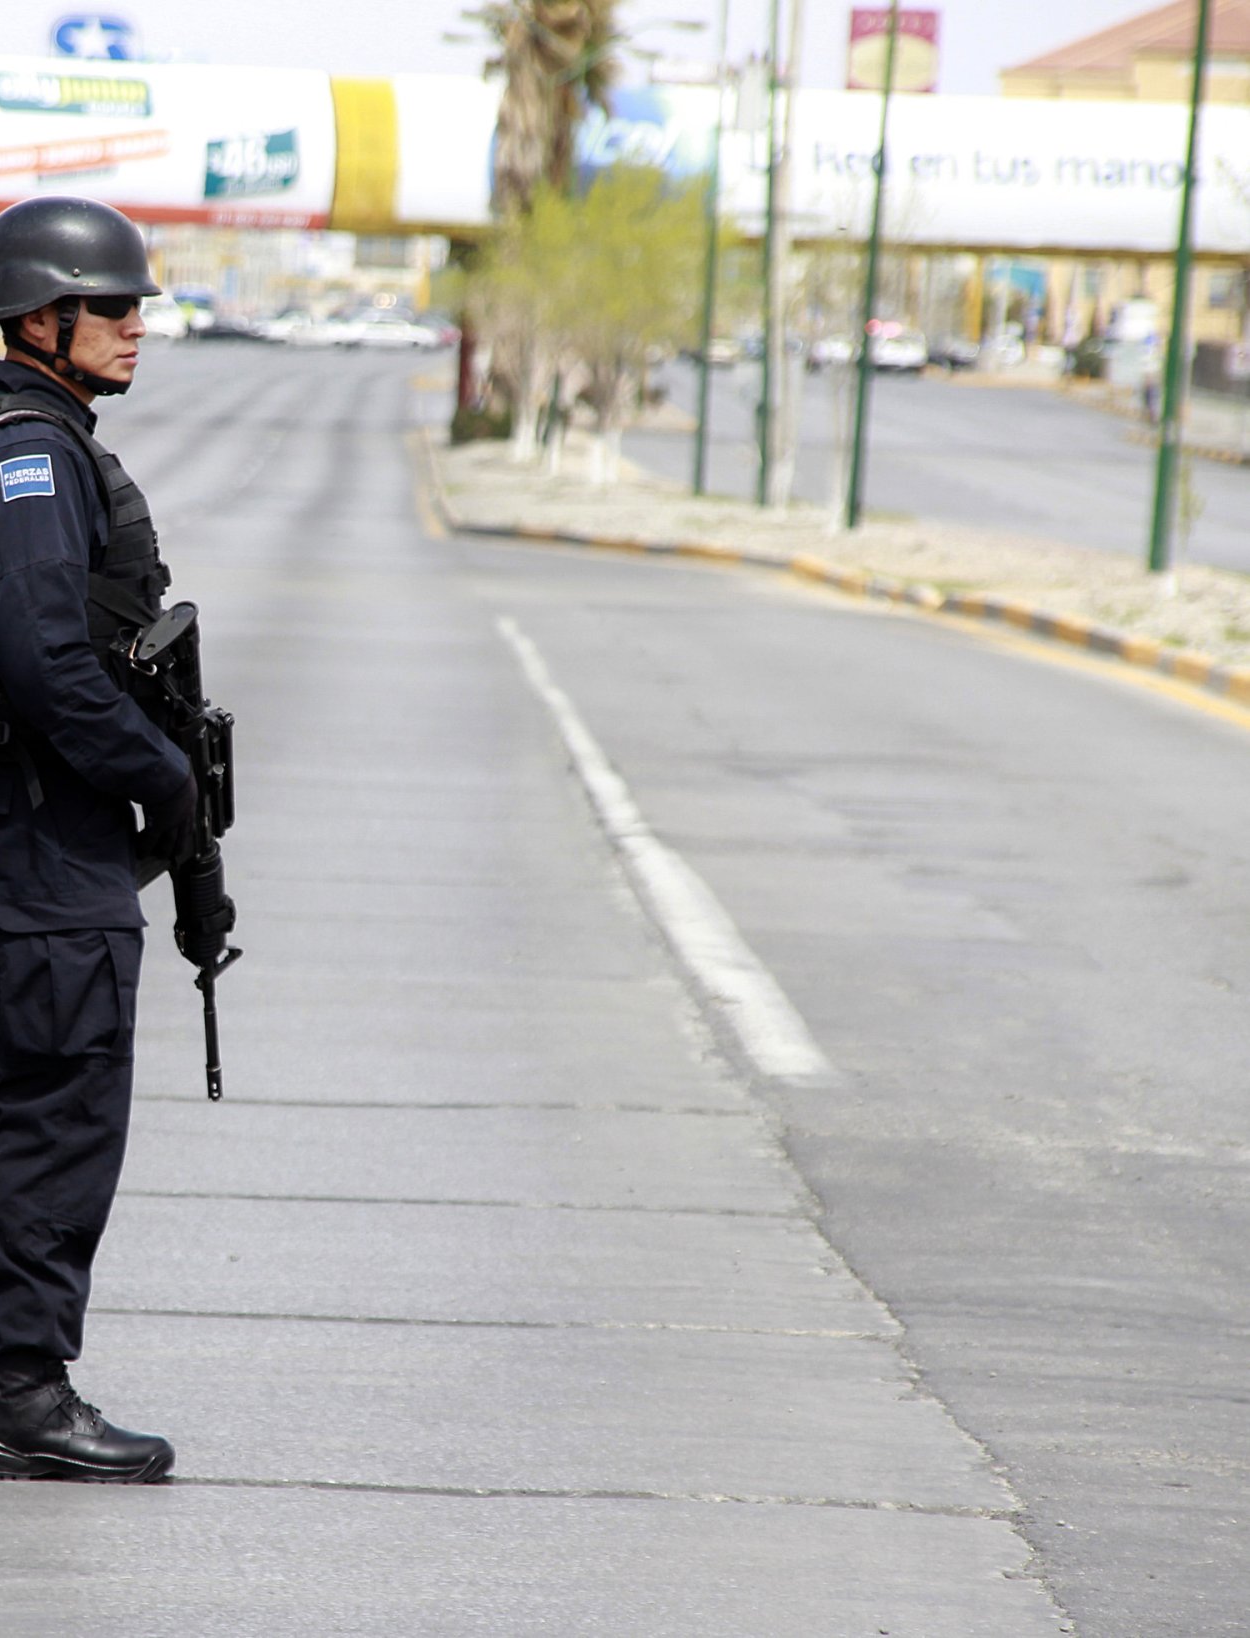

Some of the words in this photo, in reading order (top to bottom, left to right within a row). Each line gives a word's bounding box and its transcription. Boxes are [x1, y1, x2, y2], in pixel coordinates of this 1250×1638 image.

[908, 153, 958, 179] en
[972, 149, 1042, 187] tus
[1053, 156, 1199, 190] mano
[3, 467, 49, 480] FUERZAS
[5, 475, 50, 486] FEDERALES
